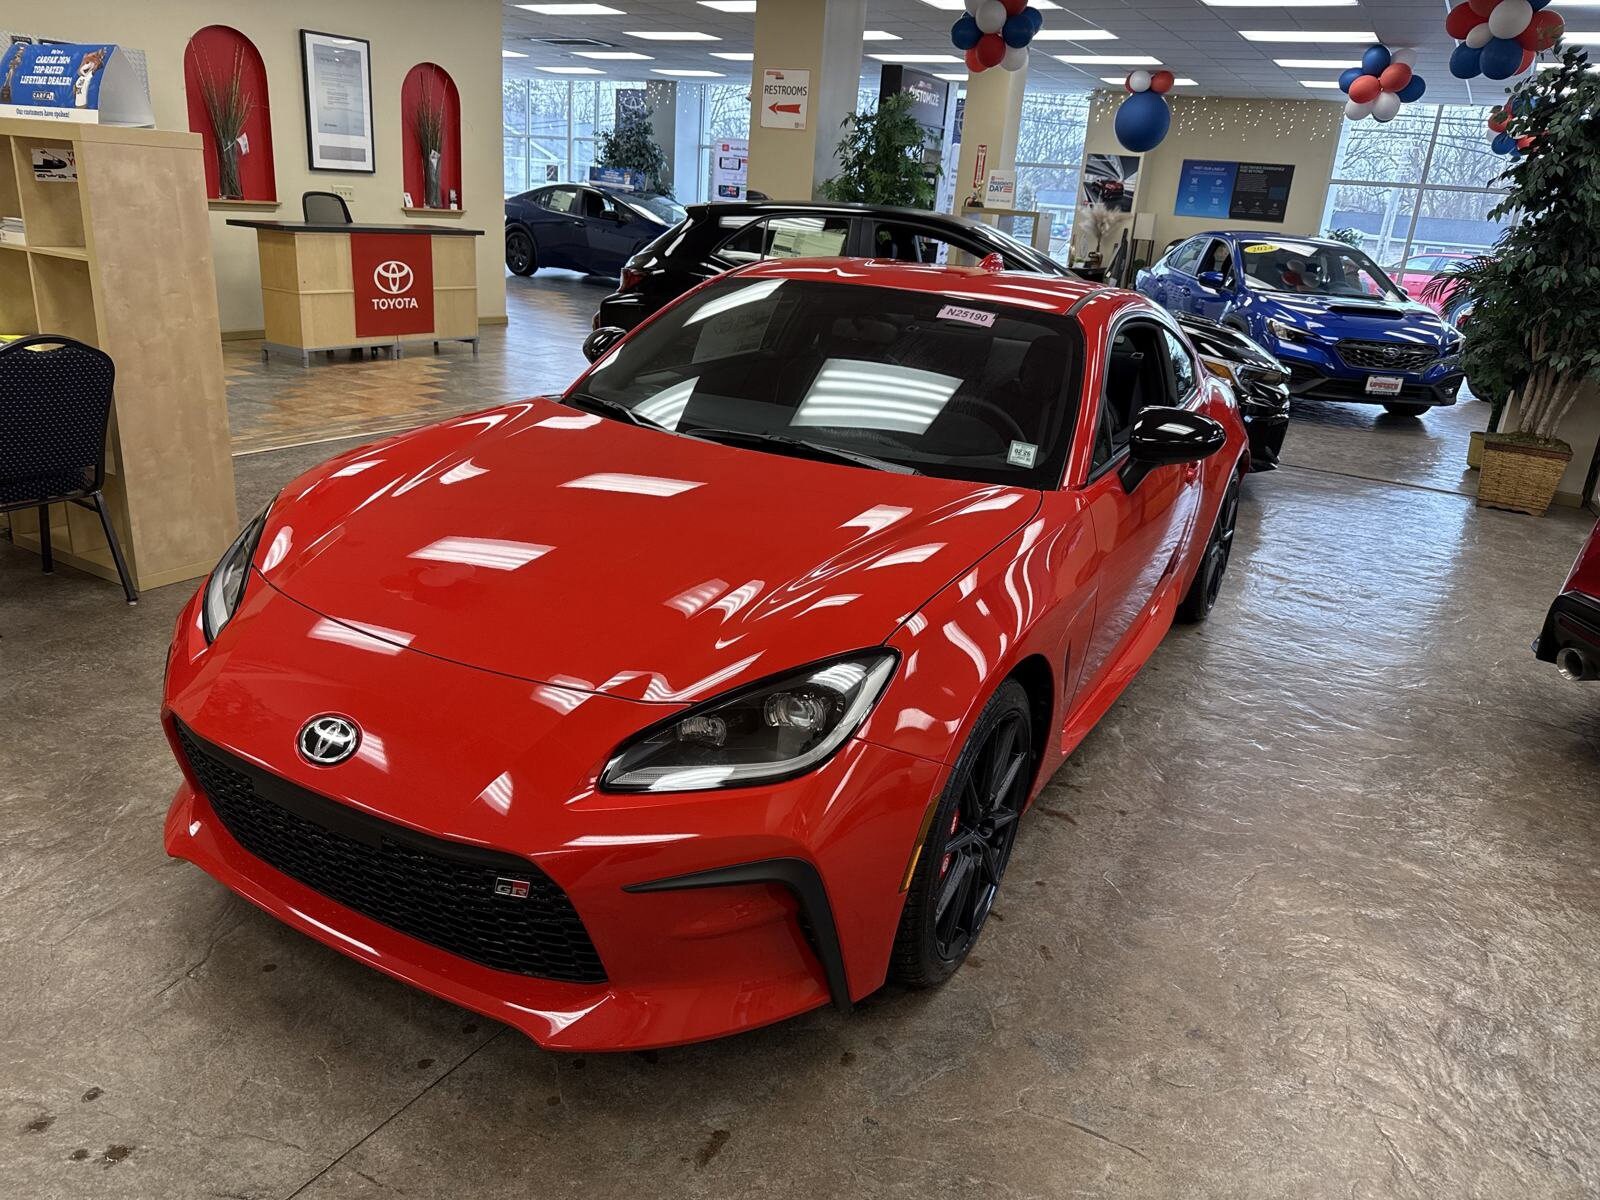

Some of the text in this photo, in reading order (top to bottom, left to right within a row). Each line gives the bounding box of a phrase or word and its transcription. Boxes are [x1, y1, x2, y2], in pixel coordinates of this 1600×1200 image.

[35, 55, 57, 64] CARFAX
[33, 65, 64, 74] TOP-RATED
[20, 75, 48, 85] LIFETIME
[764, 84, 808, 96] RESTROOMS
[989, 184, 1003, 193] DAY
[371, 298, 419, 311] TOYOTA
[946, 308, 988, 322] N25190
[496, 884, 527, 896] GR
